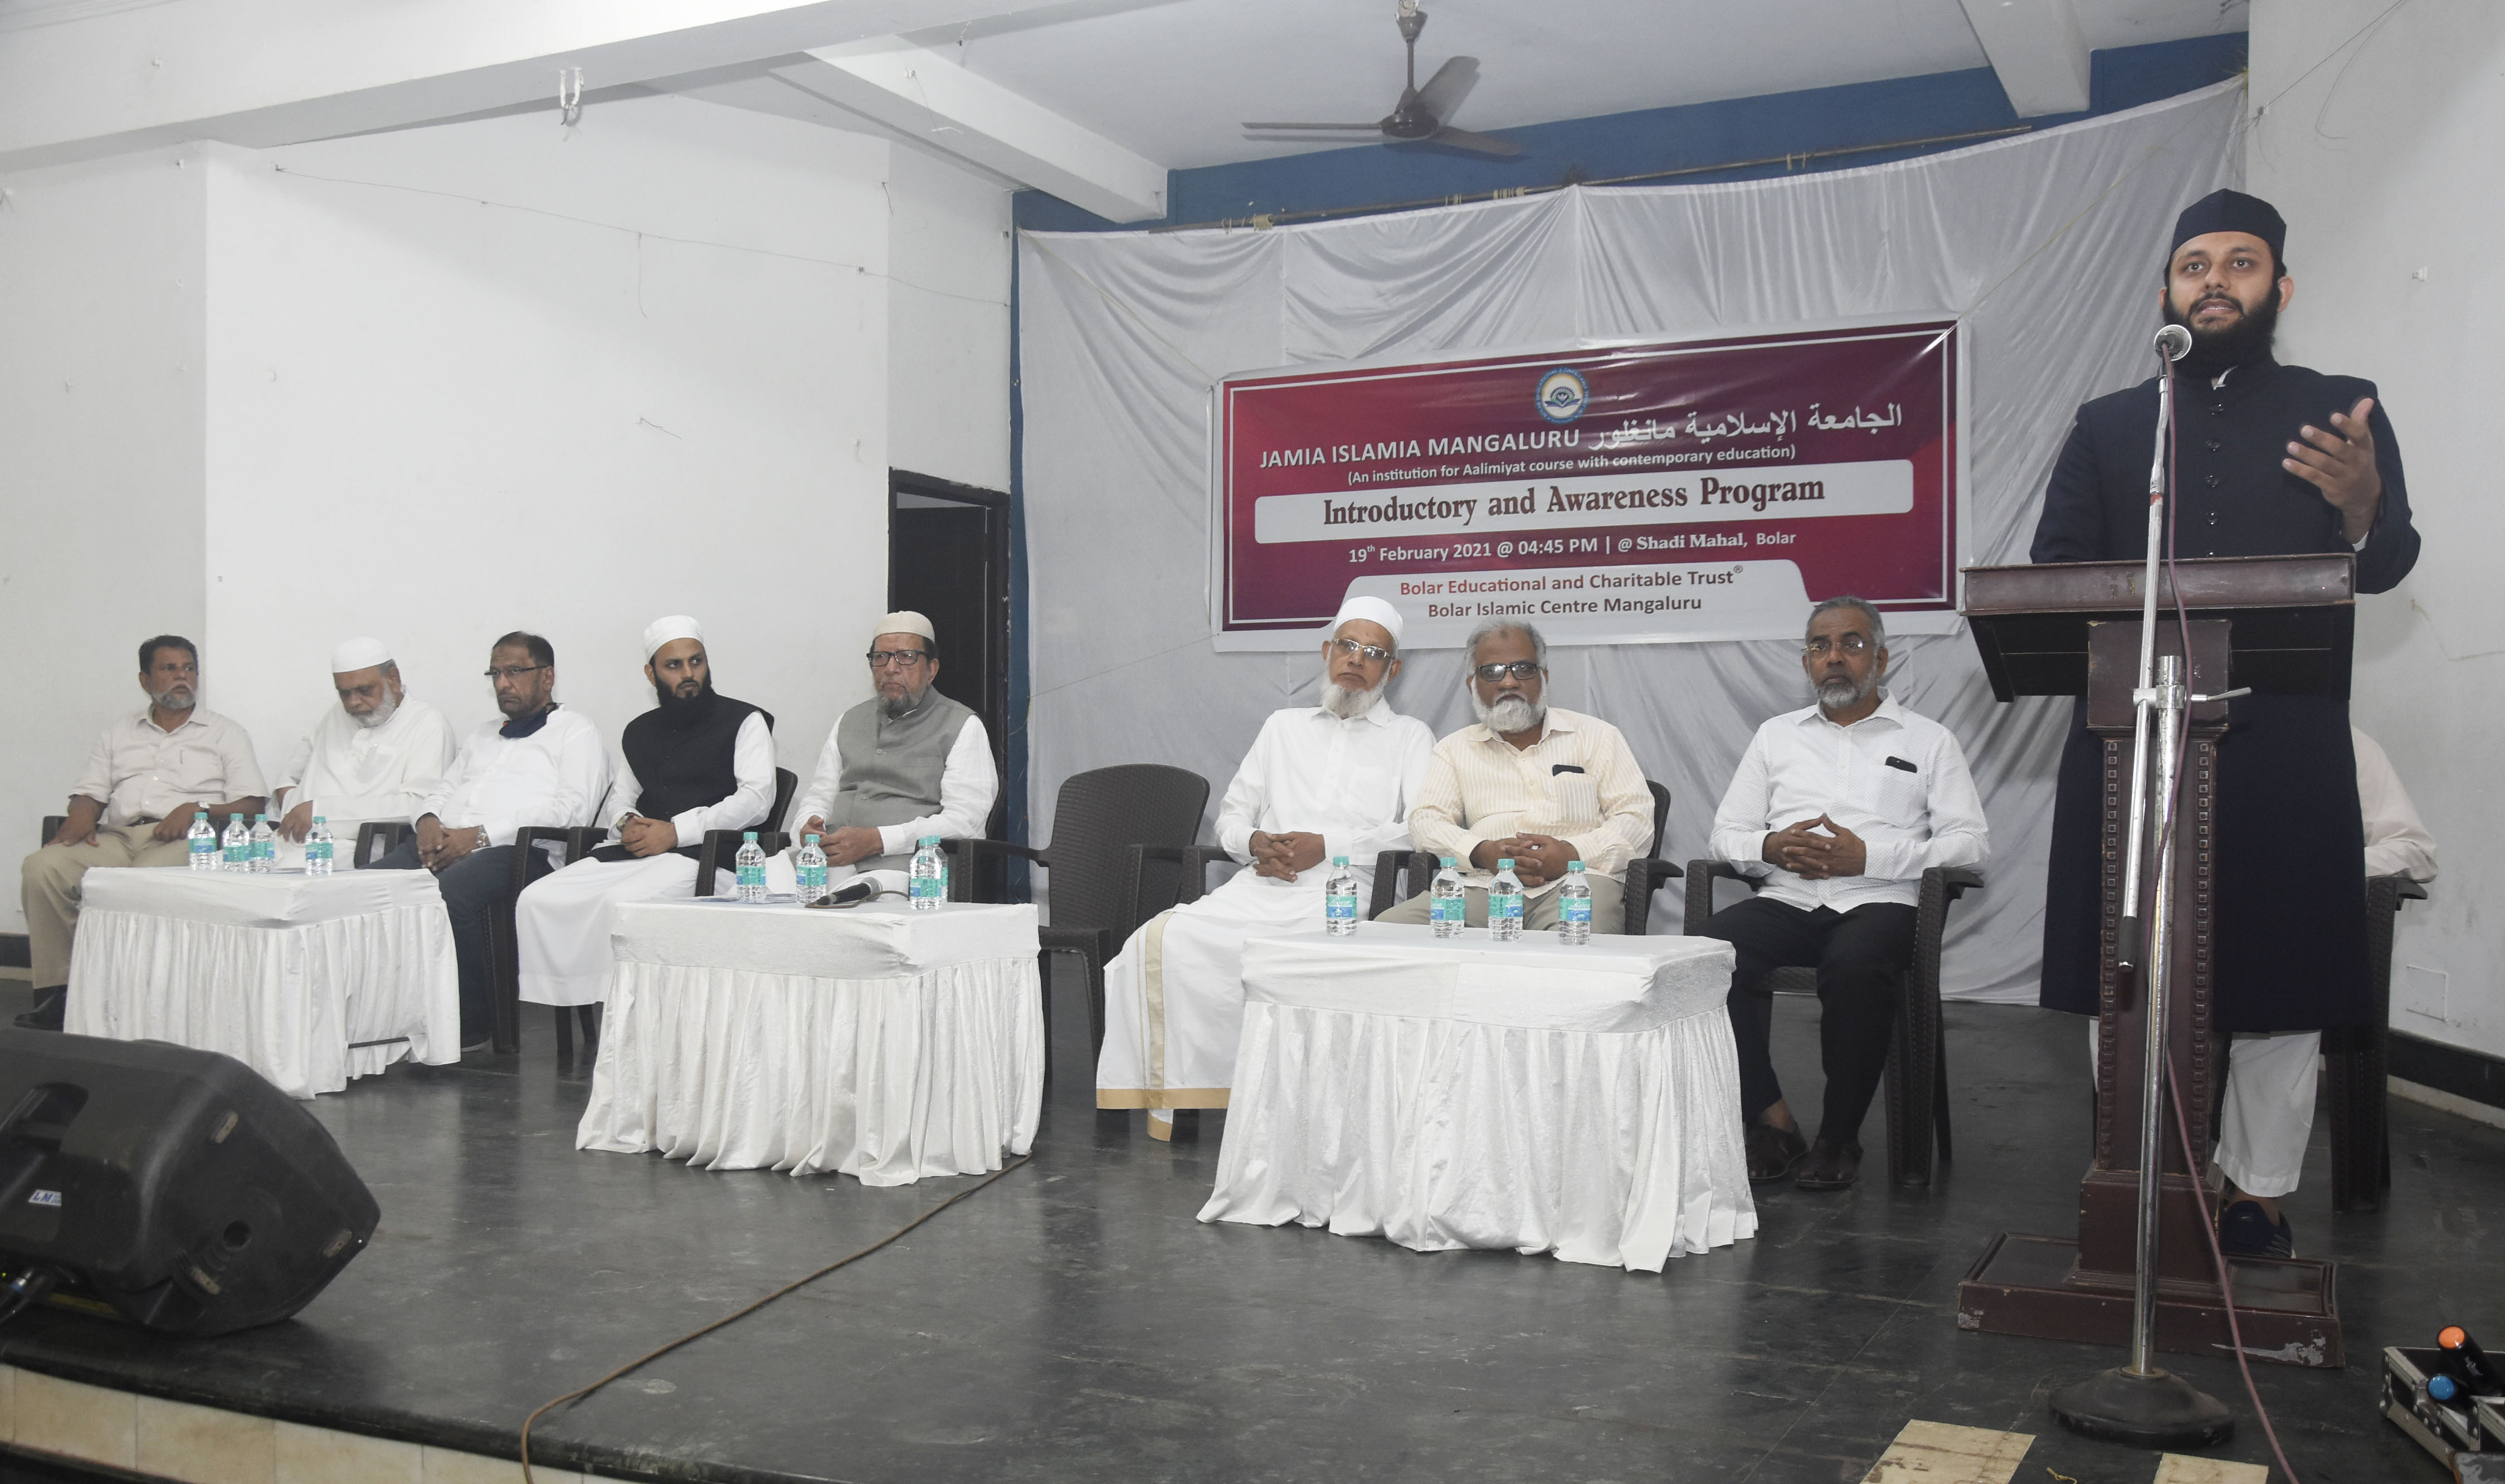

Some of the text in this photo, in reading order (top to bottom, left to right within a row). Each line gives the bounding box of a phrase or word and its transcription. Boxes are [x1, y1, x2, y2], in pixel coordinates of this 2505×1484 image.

[1685, 411, 1796, 444] الإسلامية
[1808, 403, 1902, 434] الجامعة
[1260, 429, 1580, 468] JAMIA ISLAMIA MANGALURU
[1348, 444, 1795, 486] (An institution for Aalimiyat course with contemporary education)
[1324, 477, 1825, 526] Introductory and Awareness Program
[1380, 546, 1449, 562] February
[1453, 543, 1492, 558] 2021
[1497, 541, 1513, 558] @
[1518, 539, 1563, 555] 04:45
[1570, 538, 1597, 553] PM
[1618, 538, 1632, 552] @
[1636, 535, 1685, 550] Shadi
[1690, 533, 1747, 548] Mahal,
[1757, 531, 1796, 545] Bolar
[1401, 581, 1443, 595] Bolar
[1449, 576, 1546, 593] Educational
[1552, 574, 1583, 590] and
[1590, 570, 1683, 589] Charitable
[1429, 595, 1701, 617] Bolar Islamic Centre Mangaluru
